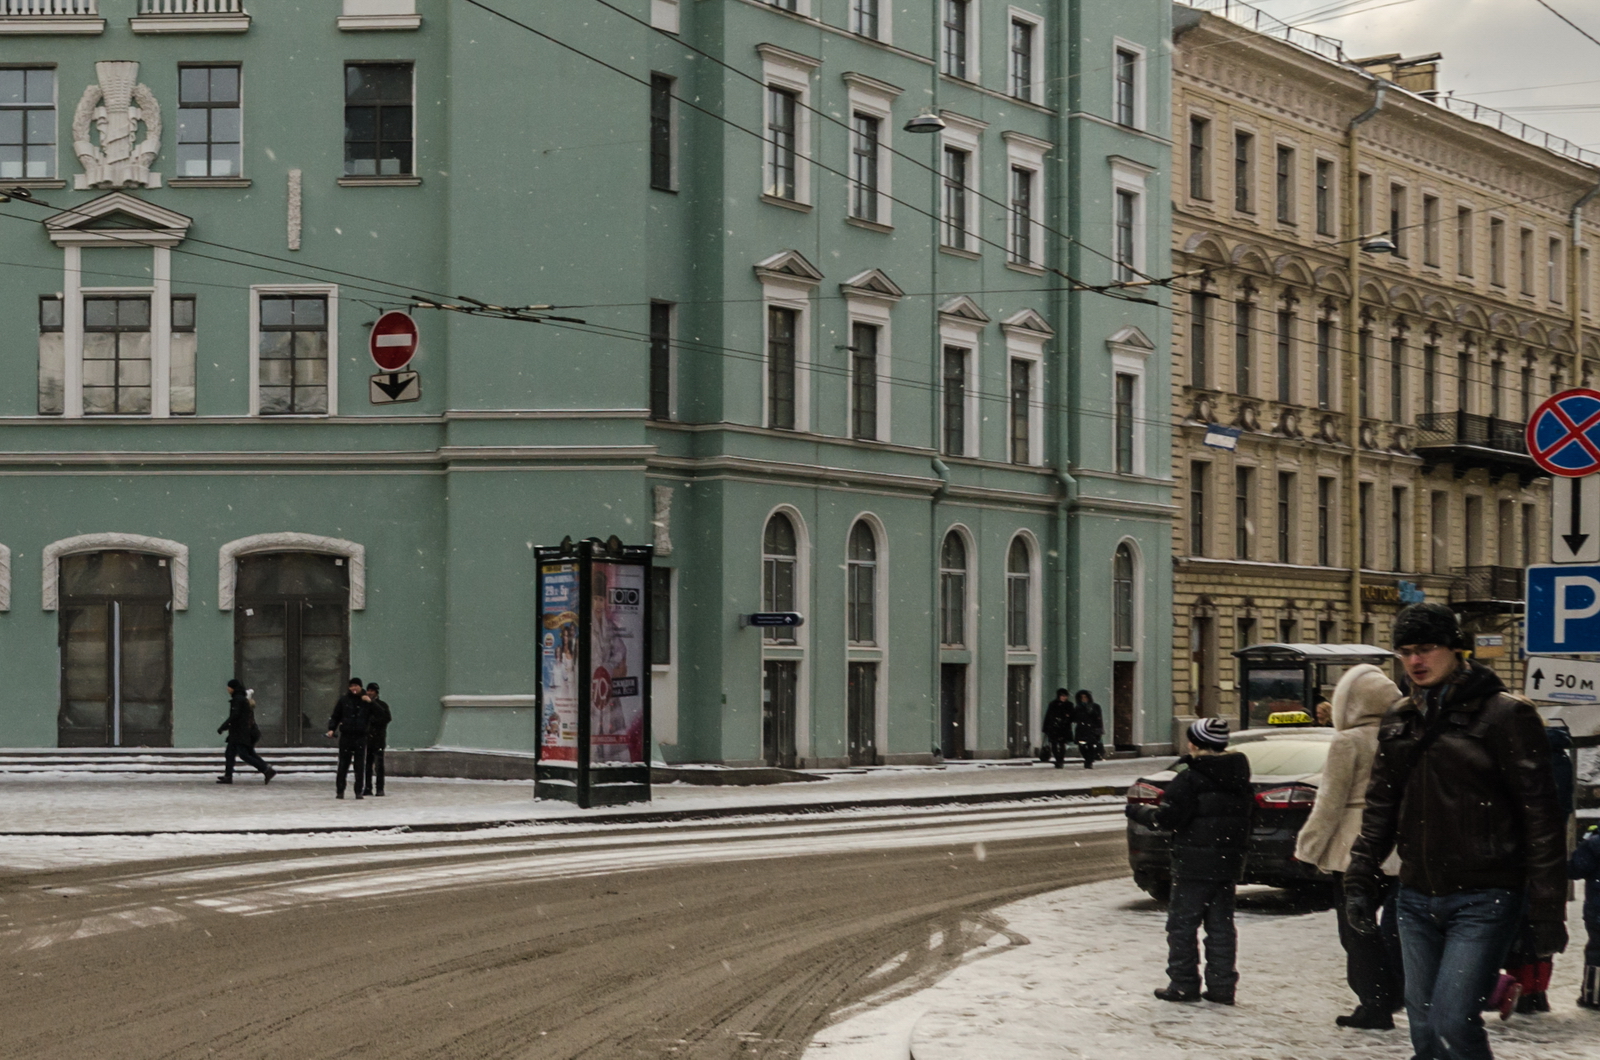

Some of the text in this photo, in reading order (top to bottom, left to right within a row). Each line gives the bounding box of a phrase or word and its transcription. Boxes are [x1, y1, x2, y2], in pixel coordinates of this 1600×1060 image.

[608, 588, 639, 604] TOTO
[1553, 575, 1600, 644] P
[1554, 673, 1577, 689] 50
